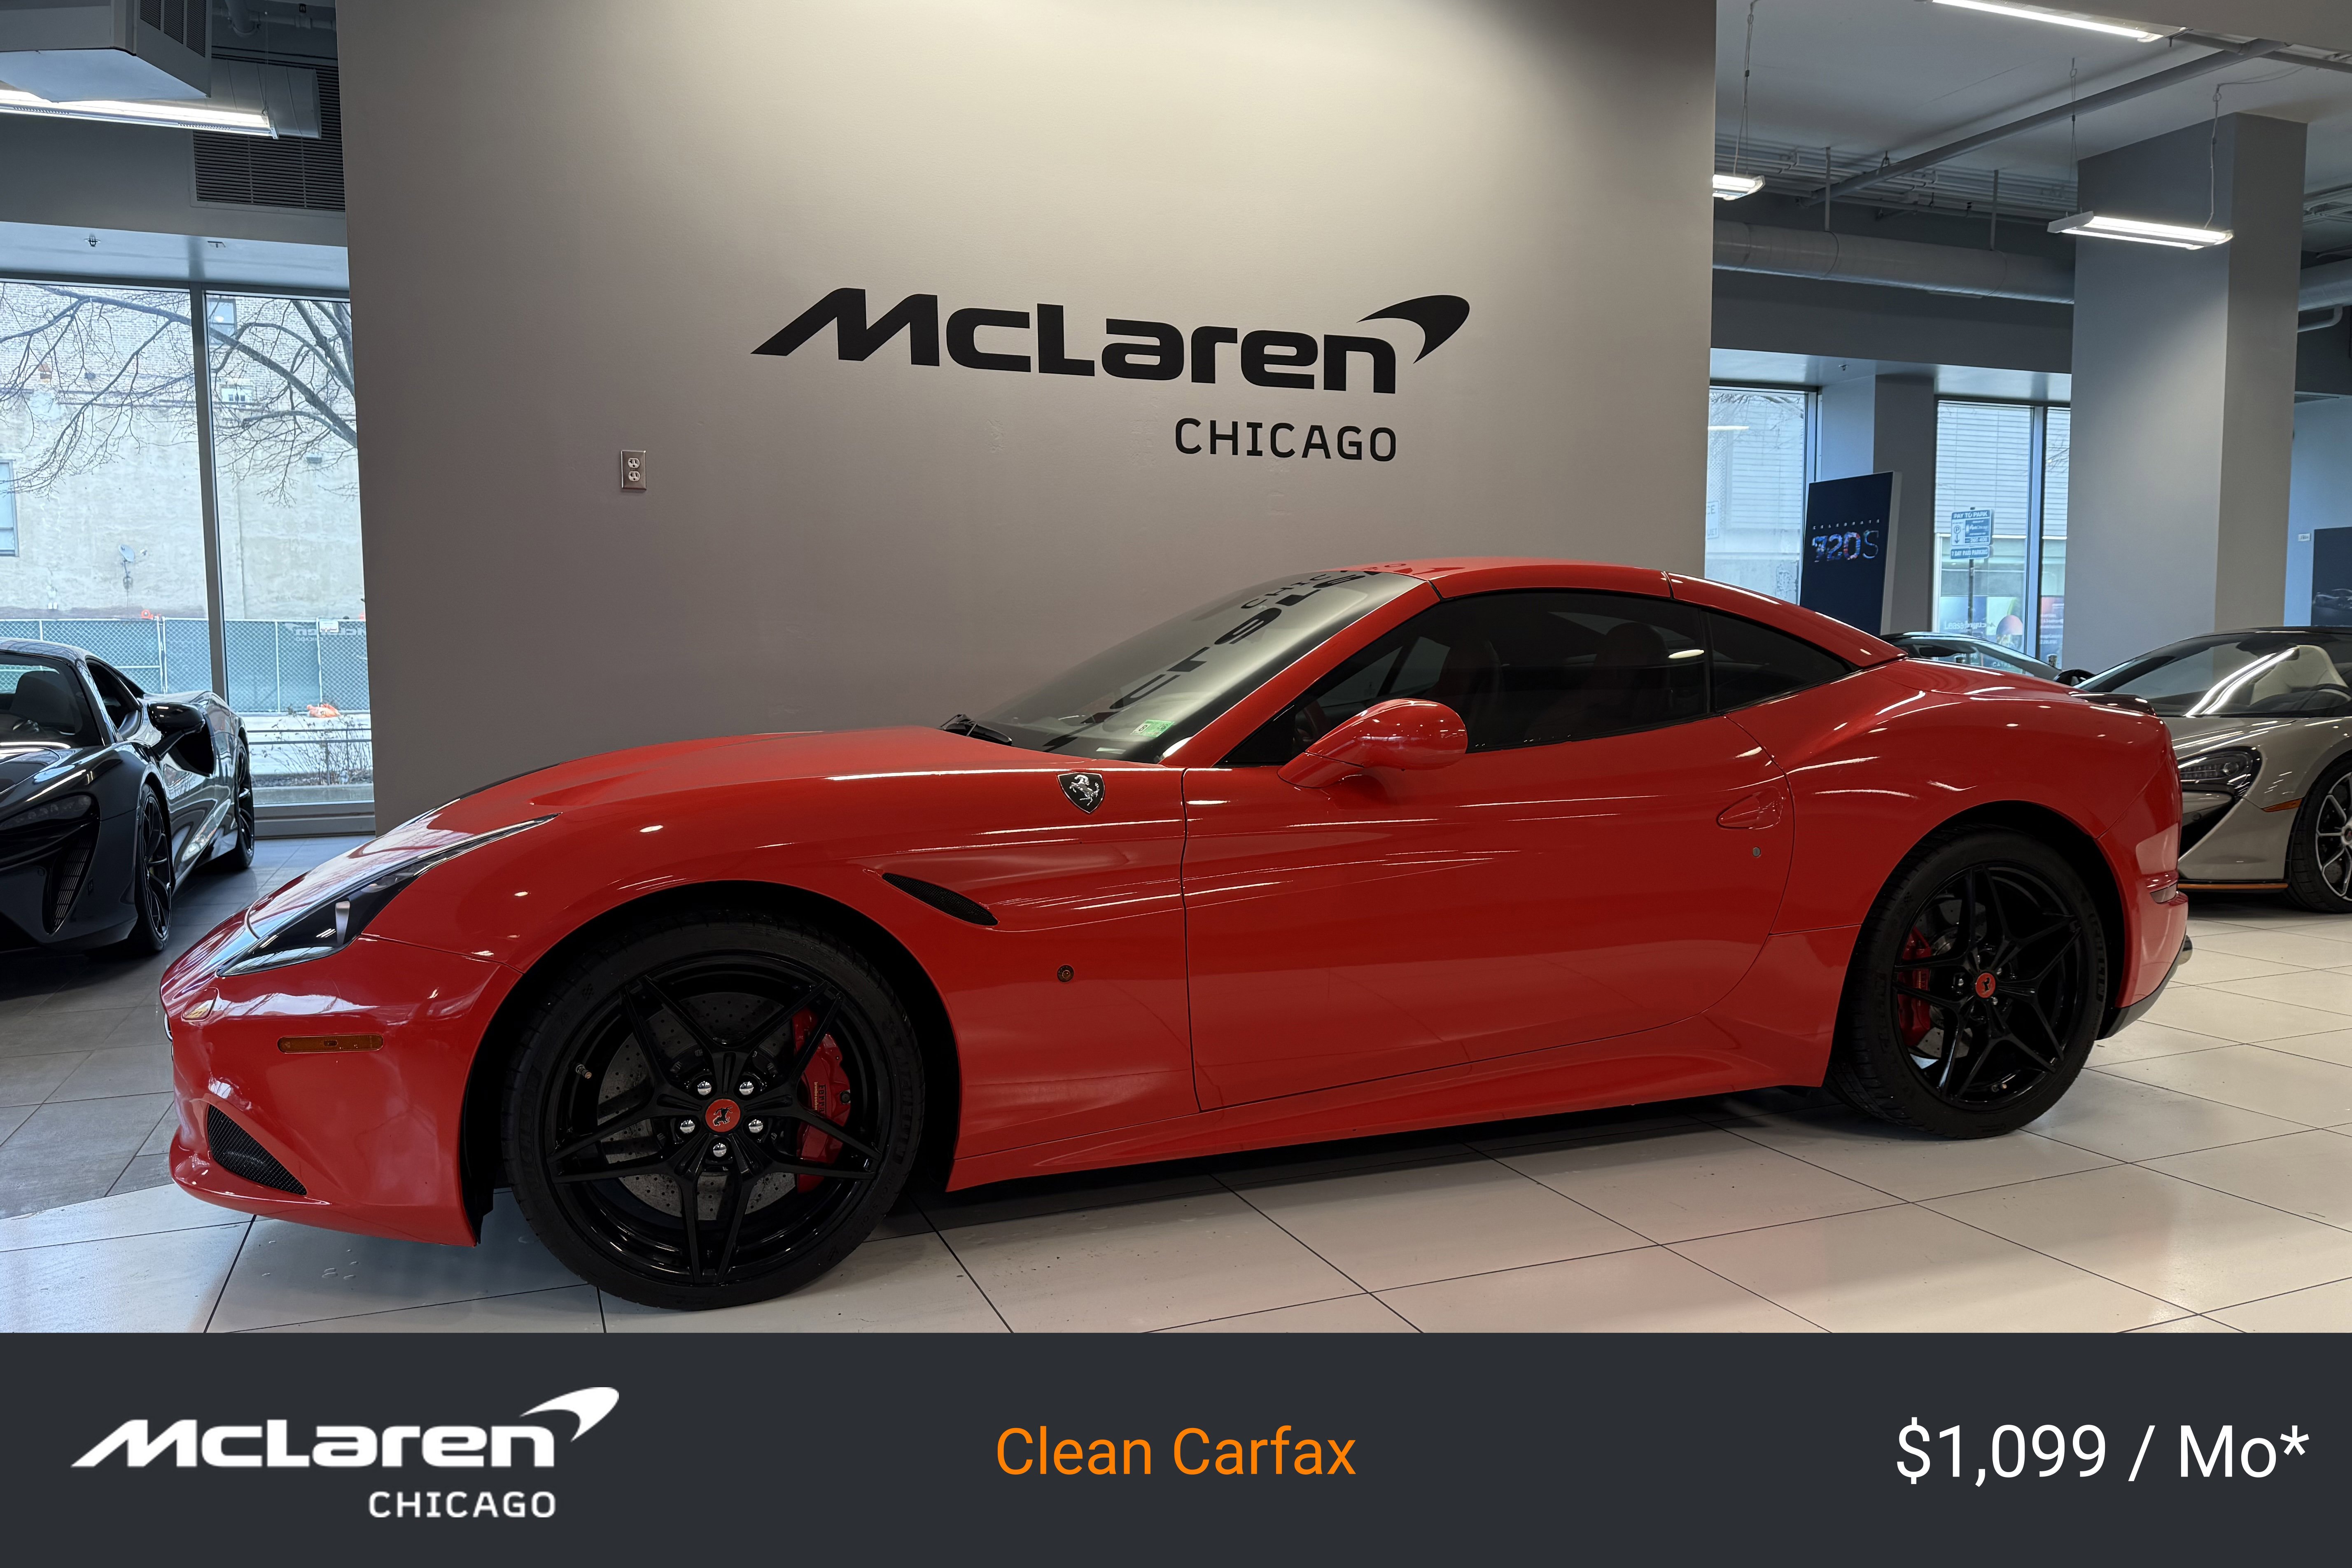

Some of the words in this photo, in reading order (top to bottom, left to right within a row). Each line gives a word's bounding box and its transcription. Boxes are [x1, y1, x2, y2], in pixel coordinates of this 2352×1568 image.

[751, 288, 1396, 394] McLaren
[1176, 418, 1396, 462] CHICAGO
[1812, 530, 1879, 562] 720S
[818, 1084, 826, 1114] Ferra
